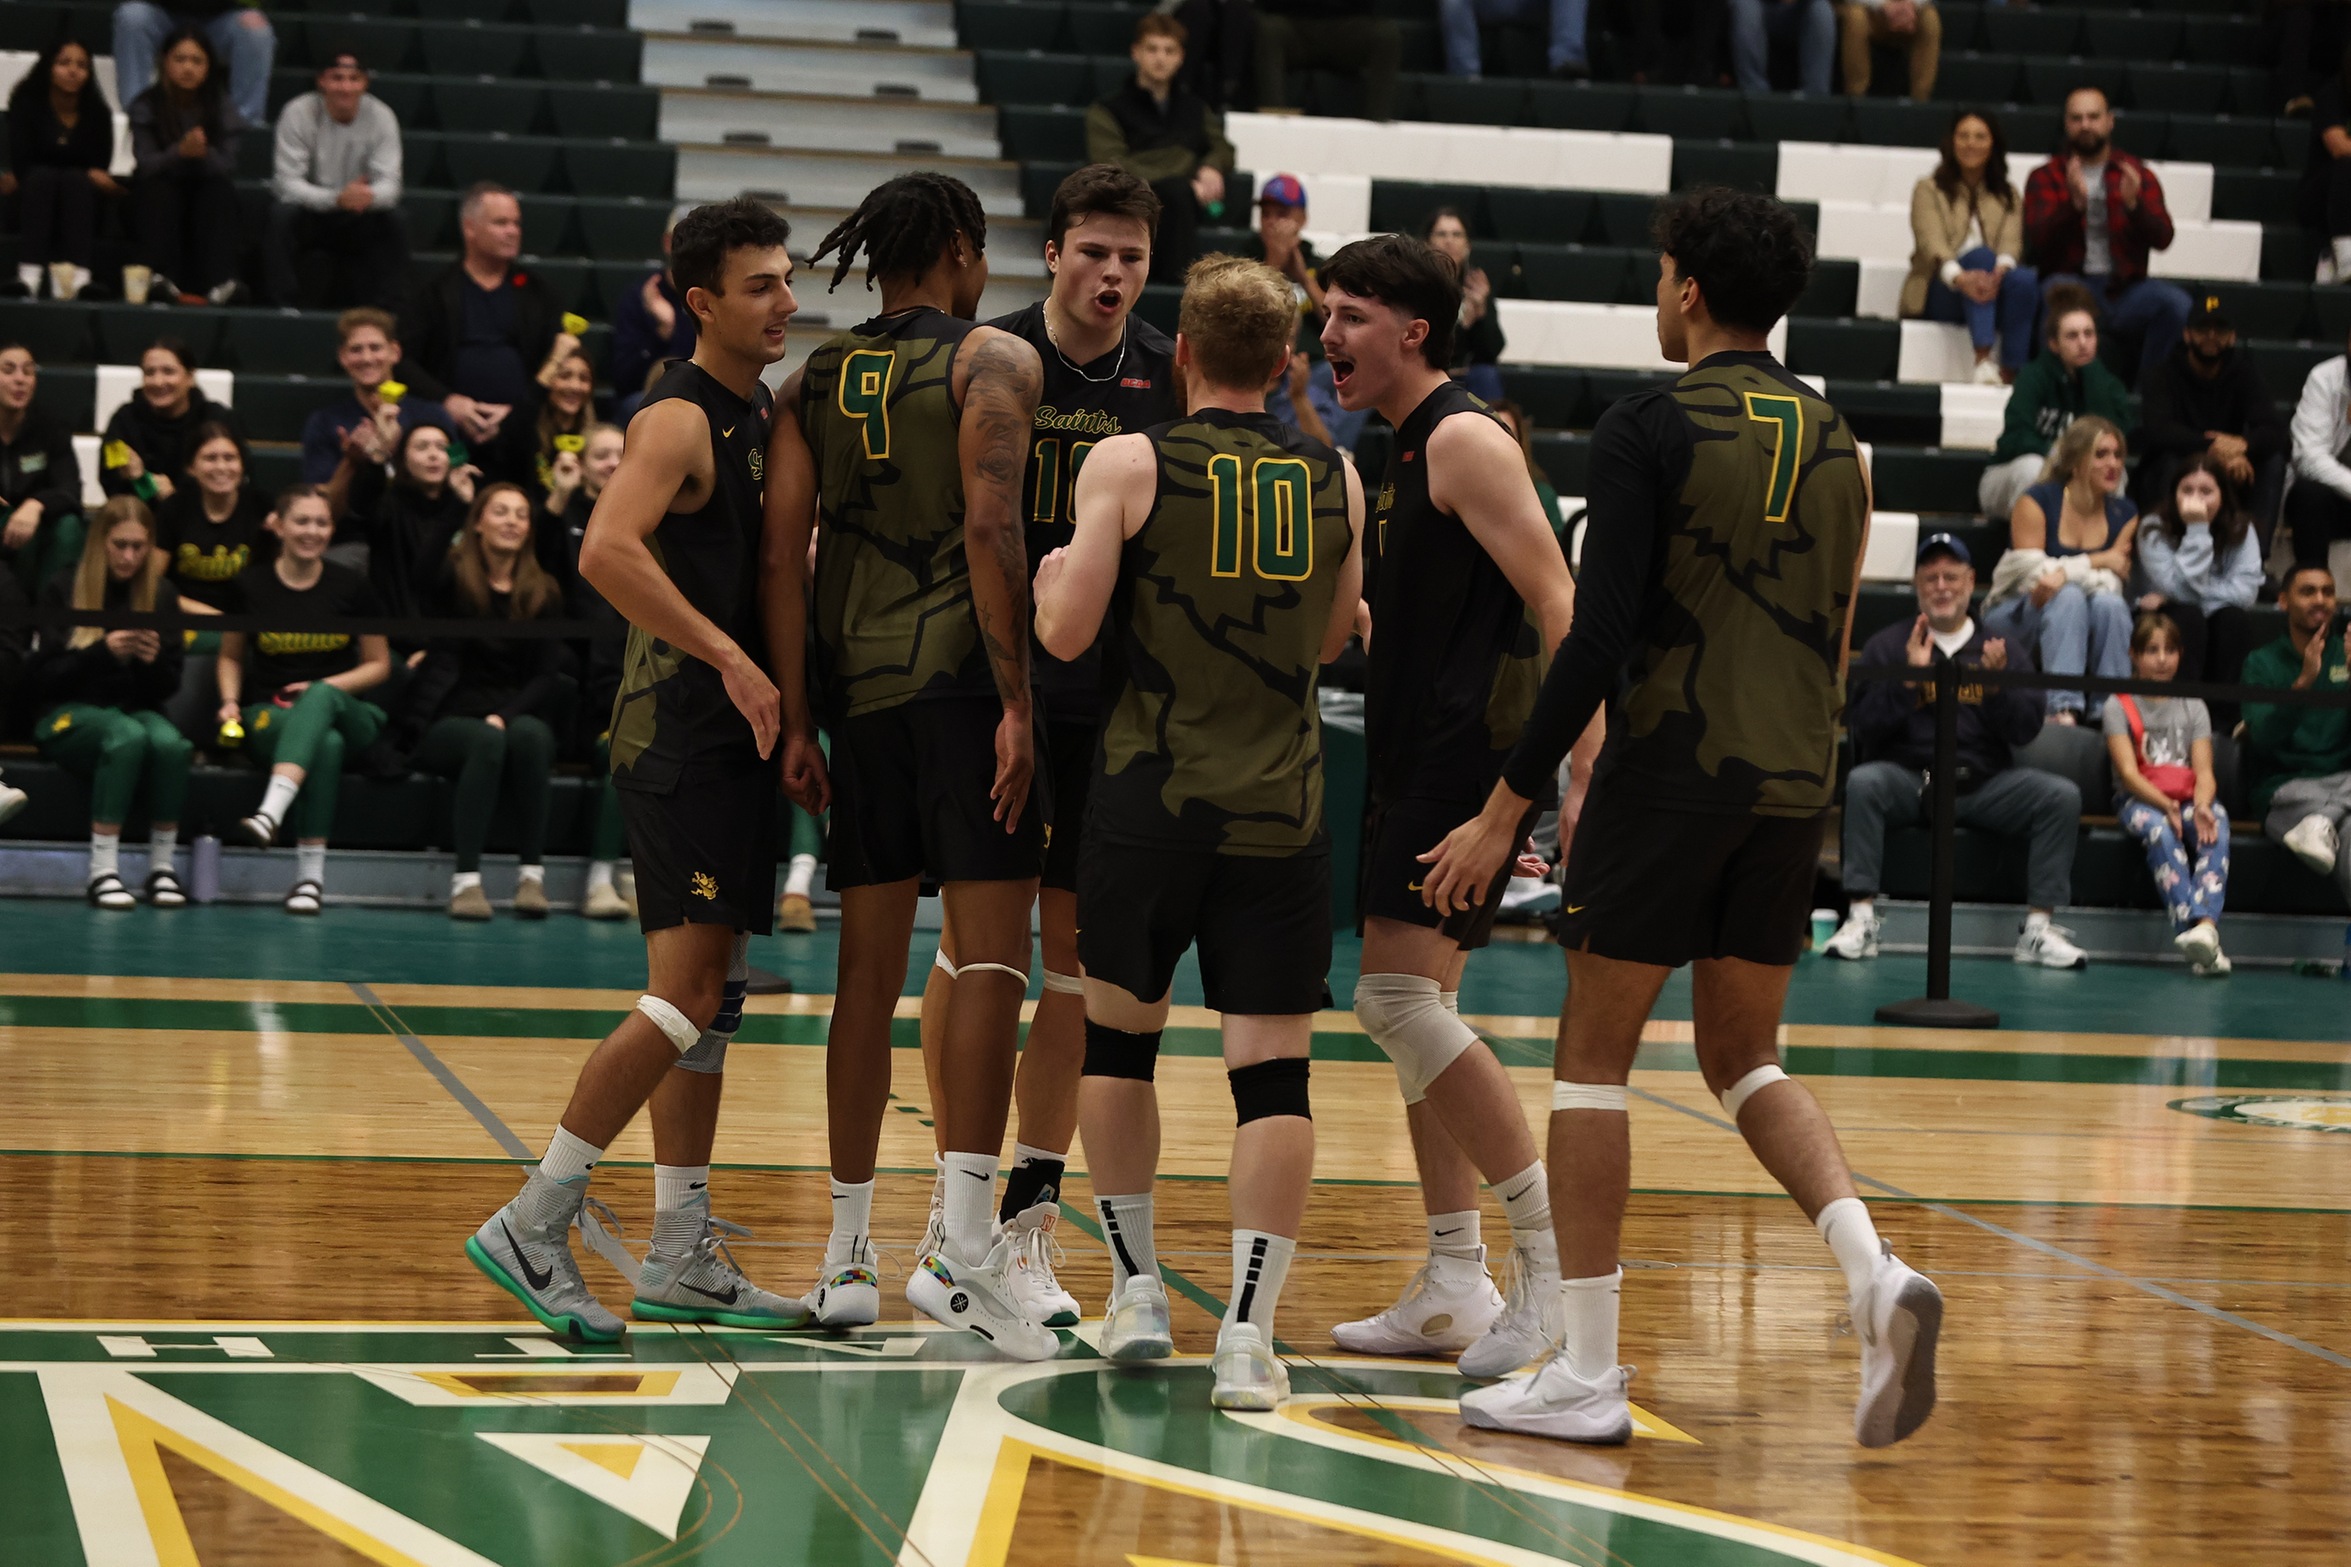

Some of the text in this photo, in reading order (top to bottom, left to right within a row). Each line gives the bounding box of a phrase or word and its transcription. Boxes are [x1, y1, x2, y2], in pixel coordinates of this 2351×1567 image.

[838, 348, 895, 460] 9
[1034, 405, 1122, 434] Saints
[1743, 391, 1804, 522] 7
[1033, 437, 1097, 525] 1
[1207, 453, 1314, 581] 10
